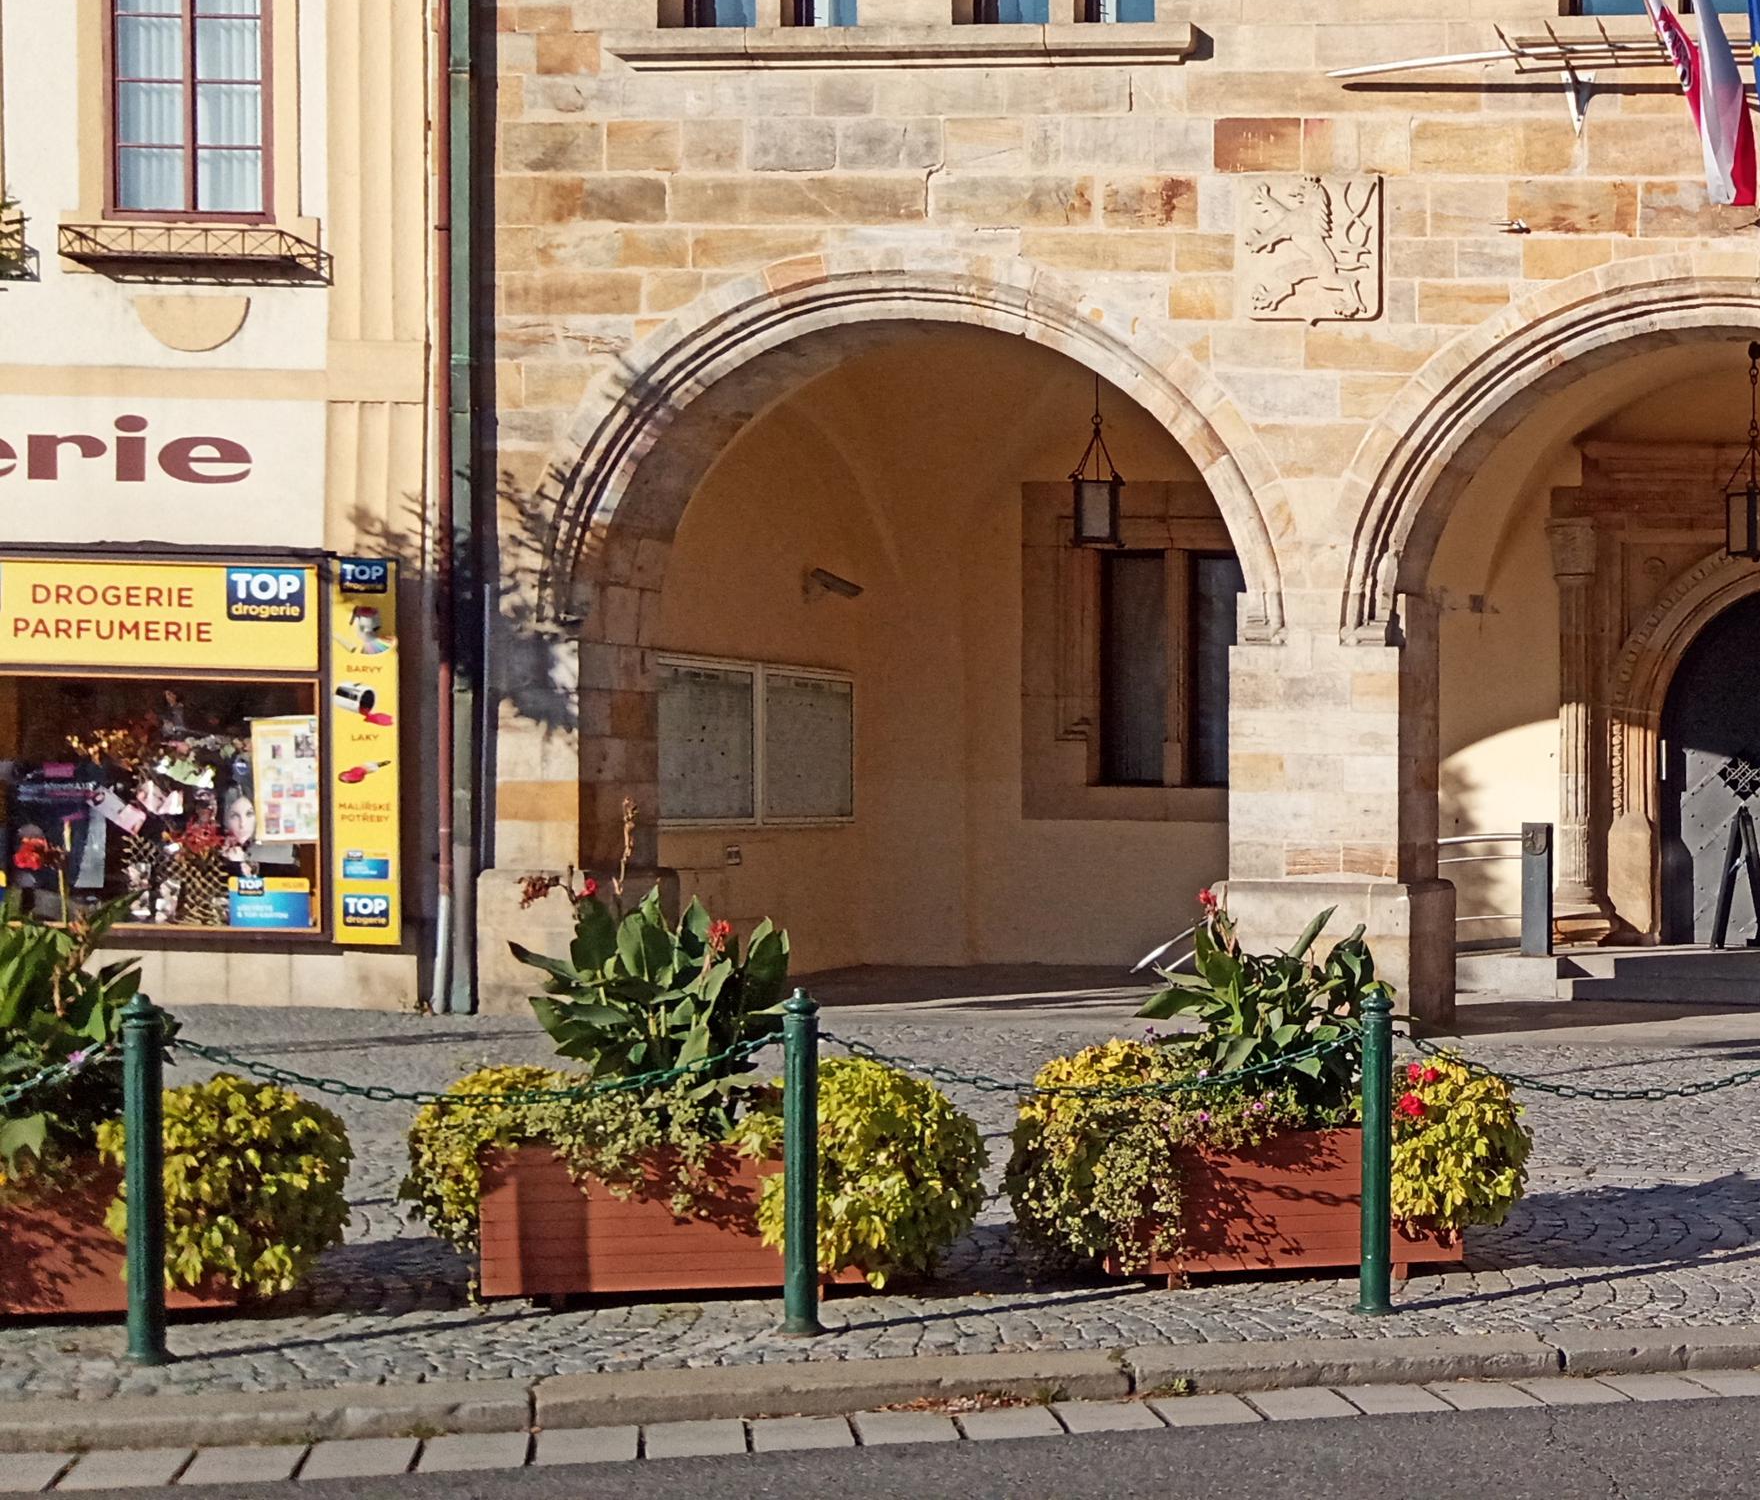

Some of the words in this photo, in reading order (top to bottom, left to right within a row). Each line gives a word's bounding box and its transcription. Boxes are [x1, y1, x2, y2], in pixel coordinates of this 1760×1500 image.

[0, 414, 253, 484] rie
[342, 564, 384, 580] TOP
[31, 583, 194, 609] DROGERIE
[230, 573, 301, 601] TOP
[231, 602, 301, 618] drogerie
[12, 617, 213, 643] PARFUMERIE
[346, 664, 382, 674] BARVY
[351, 733, 379, 742] LAKY
[345, 897, 387, 915] TOP
